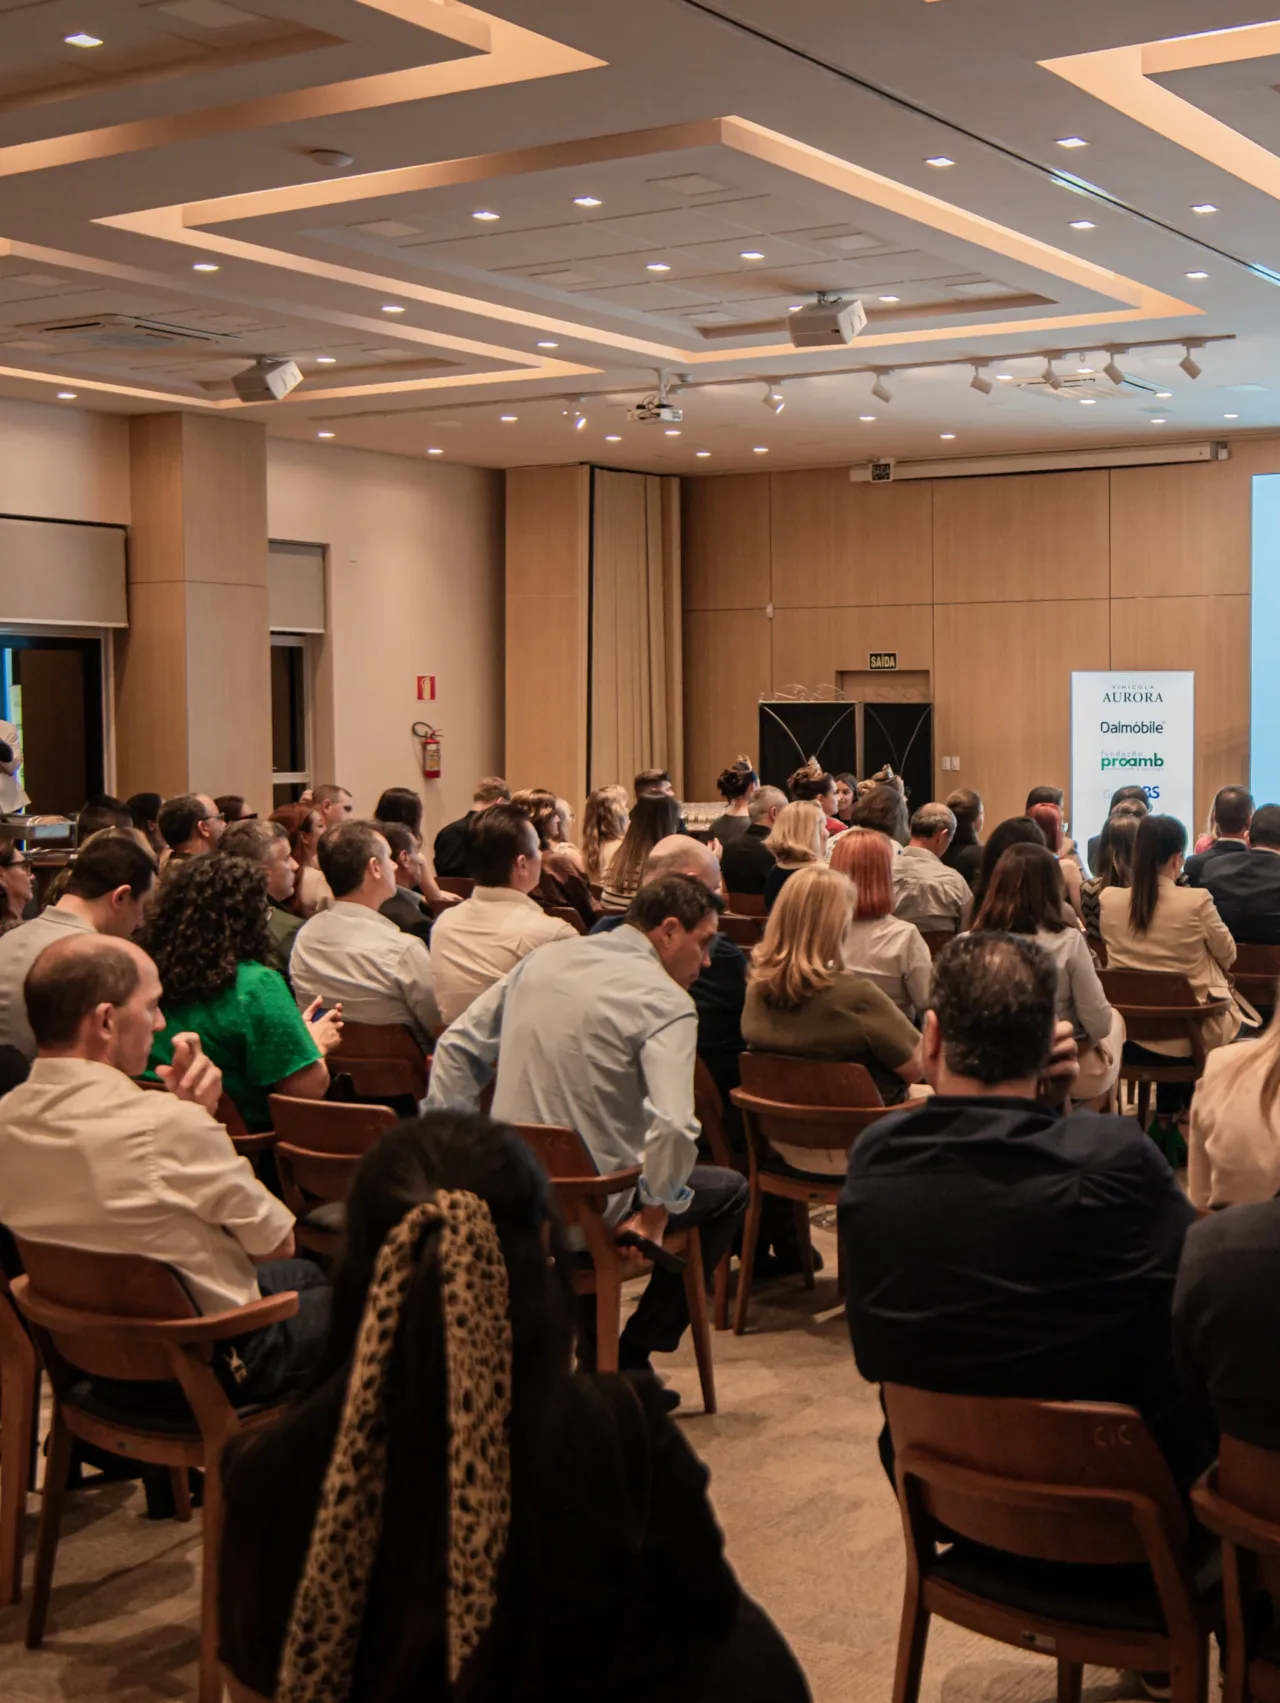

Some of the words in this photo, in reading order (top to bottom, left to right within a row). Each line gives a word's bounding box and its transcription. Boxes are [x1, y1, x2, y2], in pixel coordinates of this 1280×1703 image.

[871, 653, 895, 668] SAÍDA
[1102, 692, 1164, 703] AURORA
[1100, 721, 1164, 734] Dalmóbile
[1101, 753, 1165, 771] proamb
